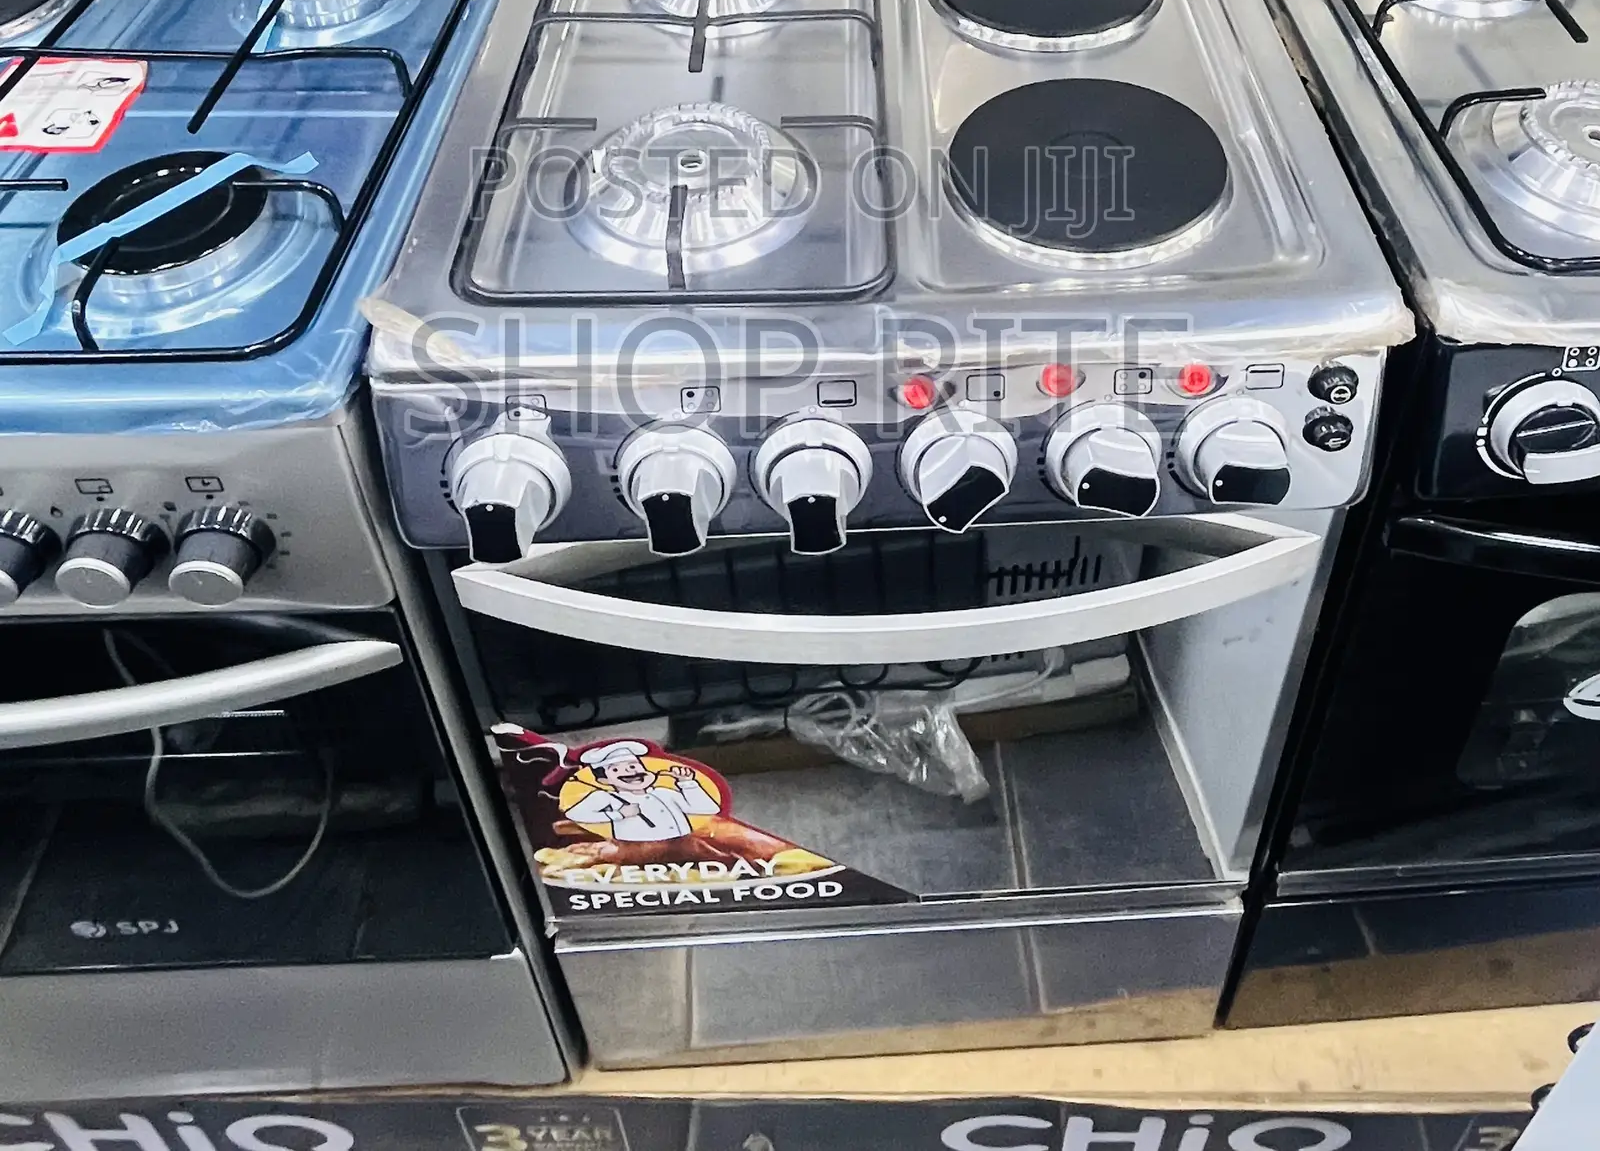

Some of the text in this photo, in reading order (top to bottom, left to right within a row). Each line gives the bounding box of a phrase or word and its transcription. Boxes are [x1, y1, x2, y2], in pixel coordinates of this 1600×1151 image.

[564, 858, 779, 886] EVERYDAY
[568, 881, 844, 912] SPECIAL FOOD
[116, 920, 179, 935] SPJ
